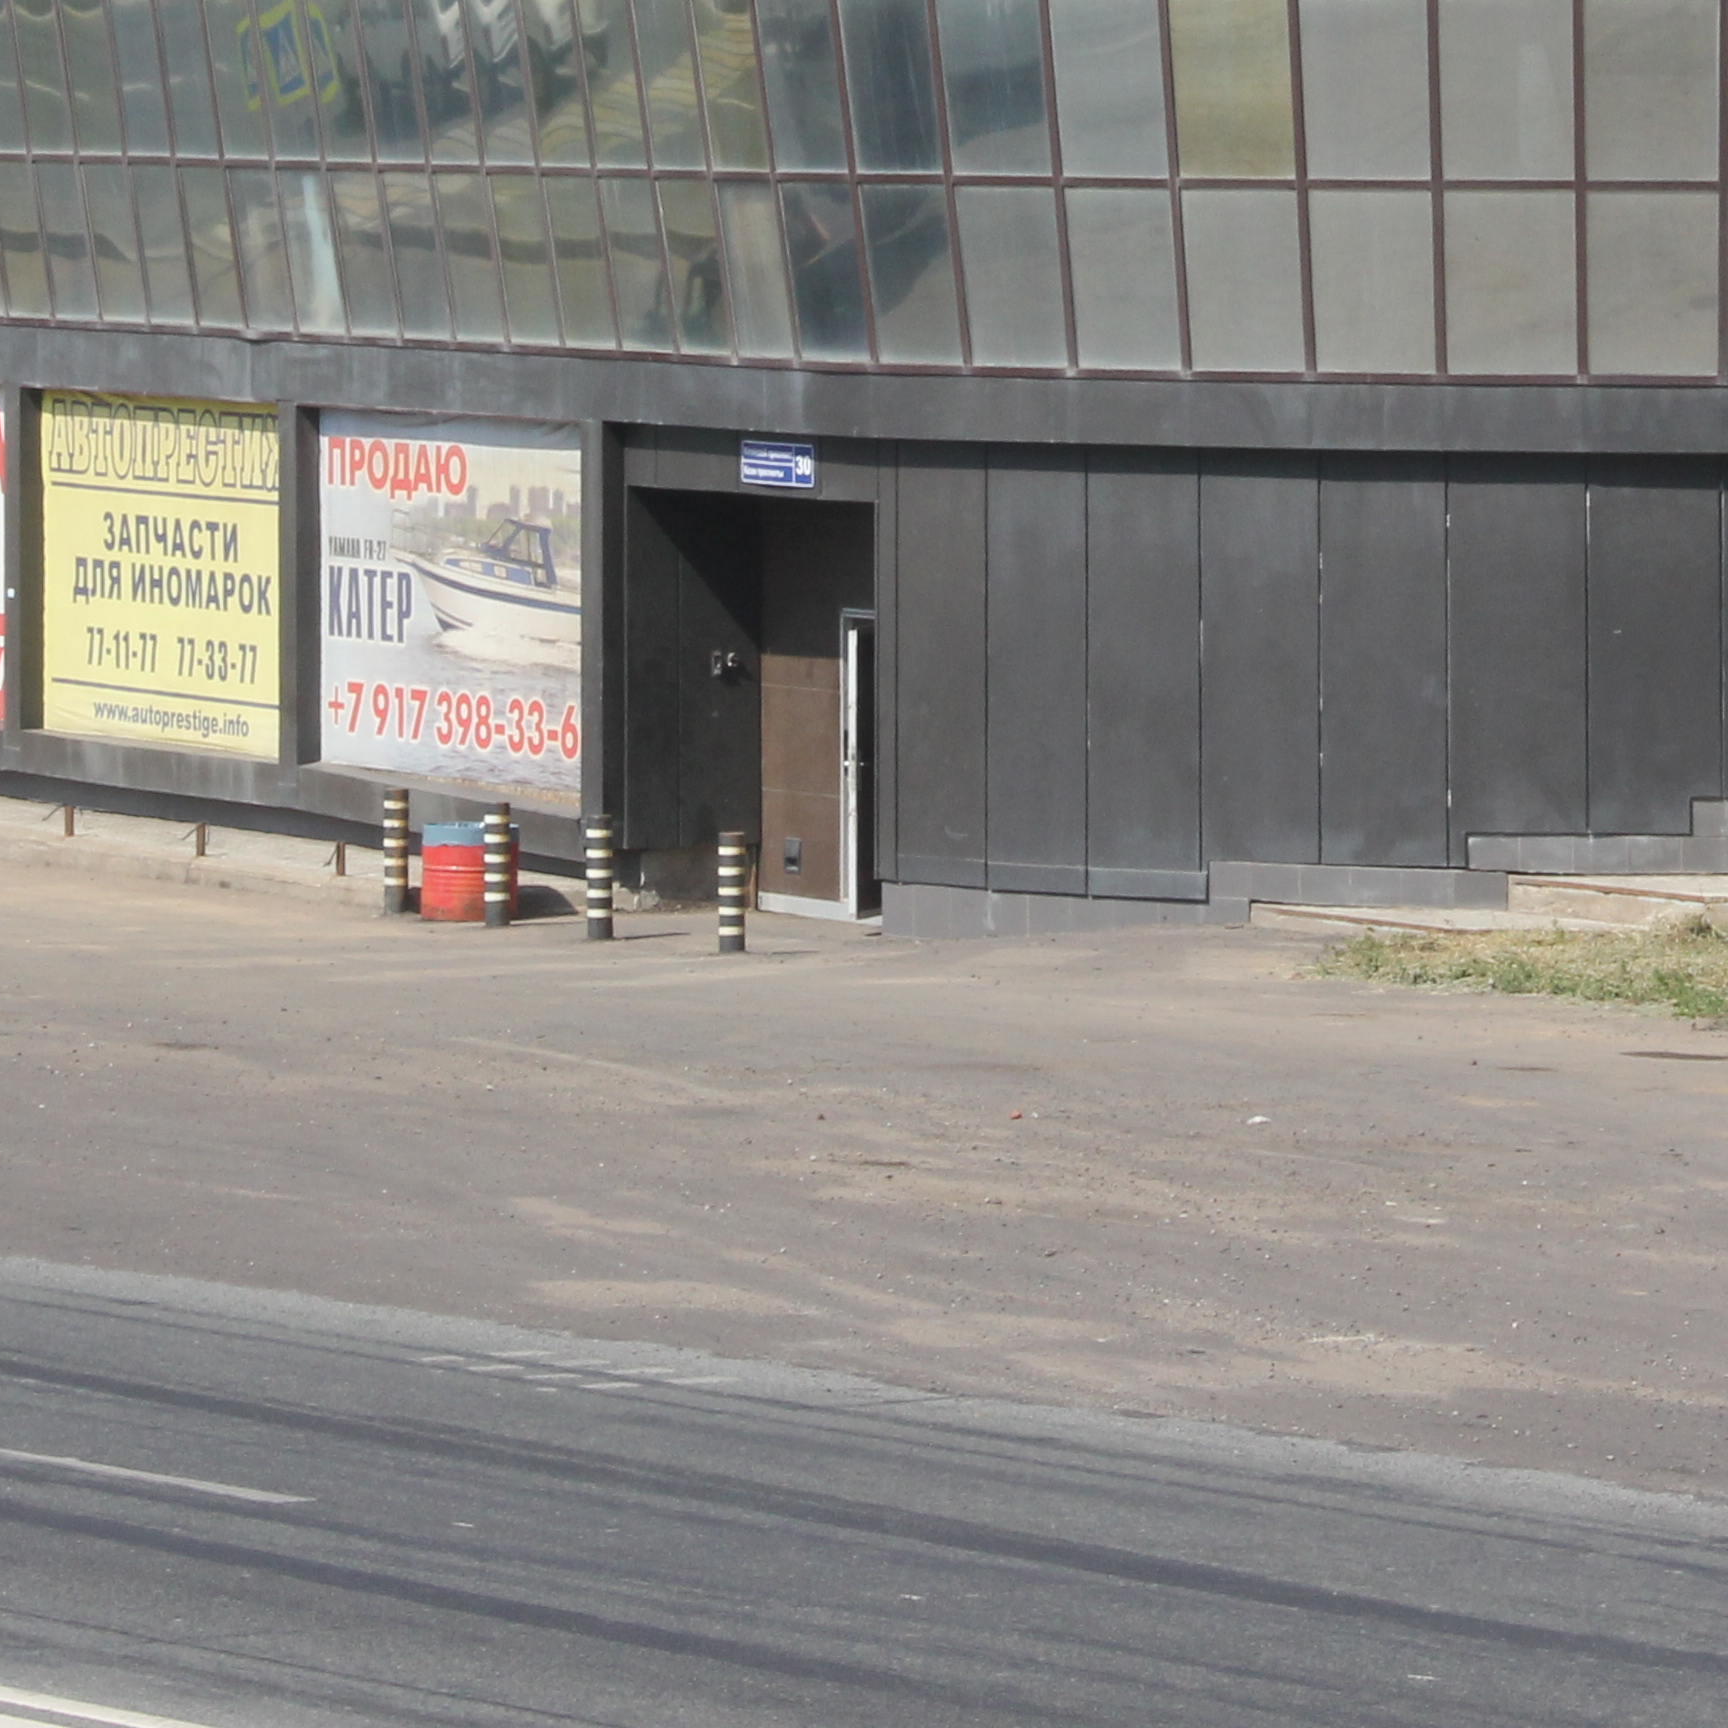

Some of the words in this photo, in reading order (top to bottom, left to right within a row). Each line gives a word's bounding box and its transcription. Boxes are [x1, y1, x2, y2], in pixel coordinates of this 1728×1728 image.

[328, 436, 467, 501] ПРОДАЮ
[795, 455, 811, 475] 30
[103, 511, 239, 563] ЗАПЧАСТИ
[73, 556, 122, 604] ДЛЯ
[131, 562, 272, 616] ИНОМАРОК
[328, 565, 412, 644] КАТЕР
[86, 626, 158, 672] 77-11-77
[177, 636, 258, 685] 77-33-77
[93, 702, 250, 738] www.autoprestige.info
[328, 681, 365, 733] +7
[373, 683, 428, 741] 917
[436, 690, 579, 760] 398-33-6
